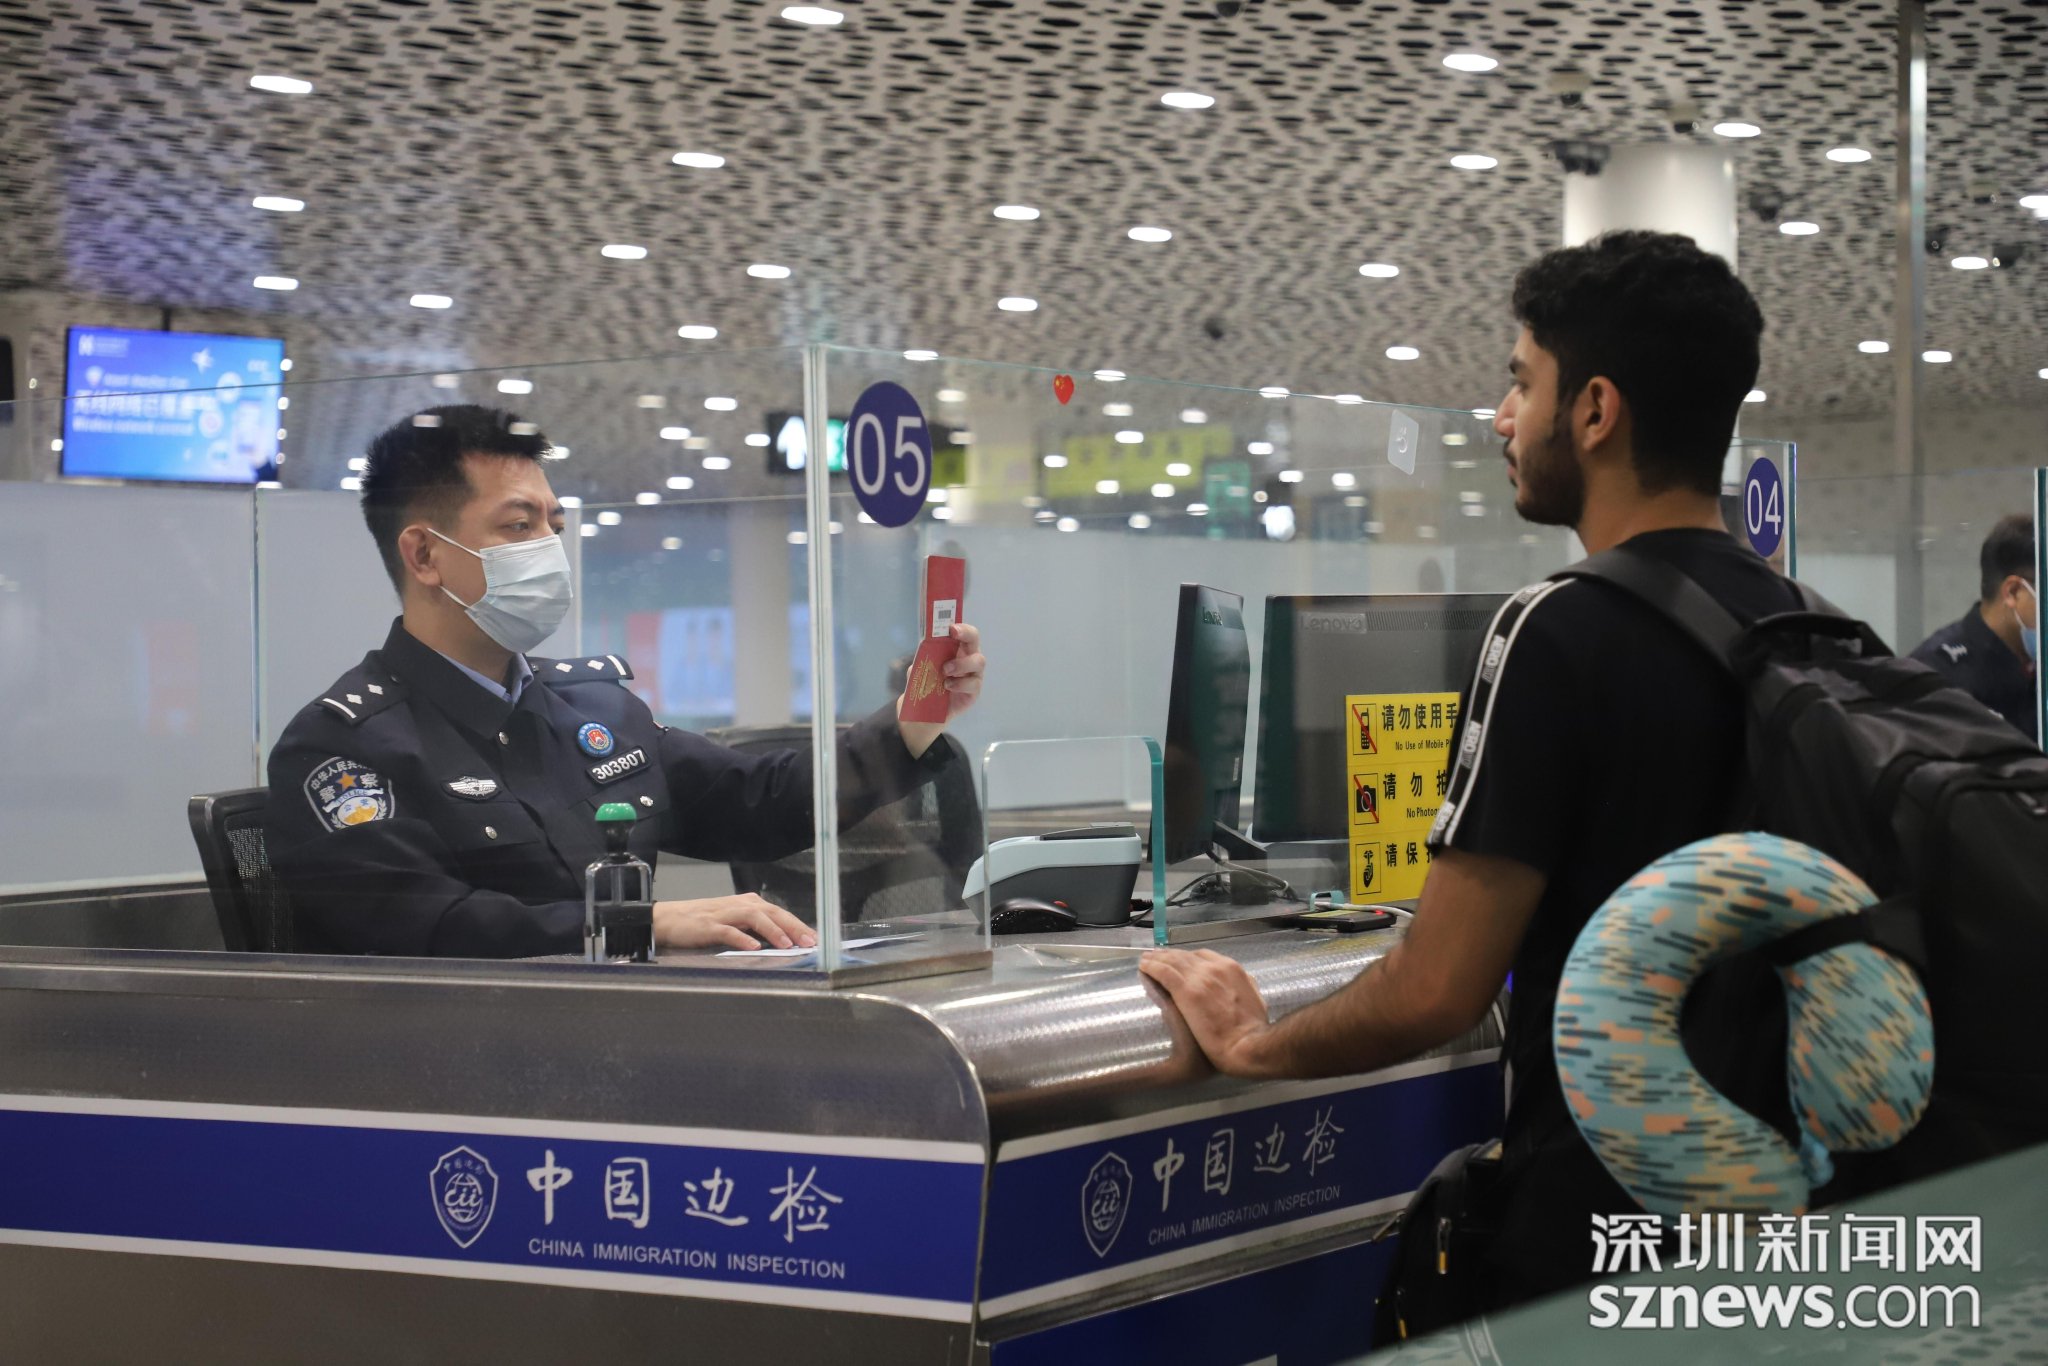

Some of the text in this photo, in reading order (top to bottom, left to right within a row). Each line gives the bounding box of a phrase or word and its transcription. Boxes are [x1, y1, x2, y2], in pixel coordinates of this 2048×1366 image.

[854, 413, 926, 496] 05
[1747, 479, 1781, 535] 04
[1300, 615, 1362, 631] Lenovo
[1382, 703, 1458, 731] 请勿使用手
[1395, 741, 1403, 750] No
[1405, 740, 1416, 750] Use
[1418, 740, 1423, 749] of
[1425, 739, 1443, 749] Mobile
[311, 761, 372, 790] 中华人民共
[592, 749, 646, 780] 303807
[1406, 807, 1440, 818] No Photog
[1153, 1106, 1344, 1212] 中国边检
[526, 1149, 843, 1243] 中国边检
[1149, 1222, 1186, 1246] CHINA
[1191, 1203, 1269, 1235] IMMIGRATION
[1274, 1185, 1341, 1213] INSPECTION
[528, 1238, 845, 1279] CHINA IMMIGRATION INSPECTION
